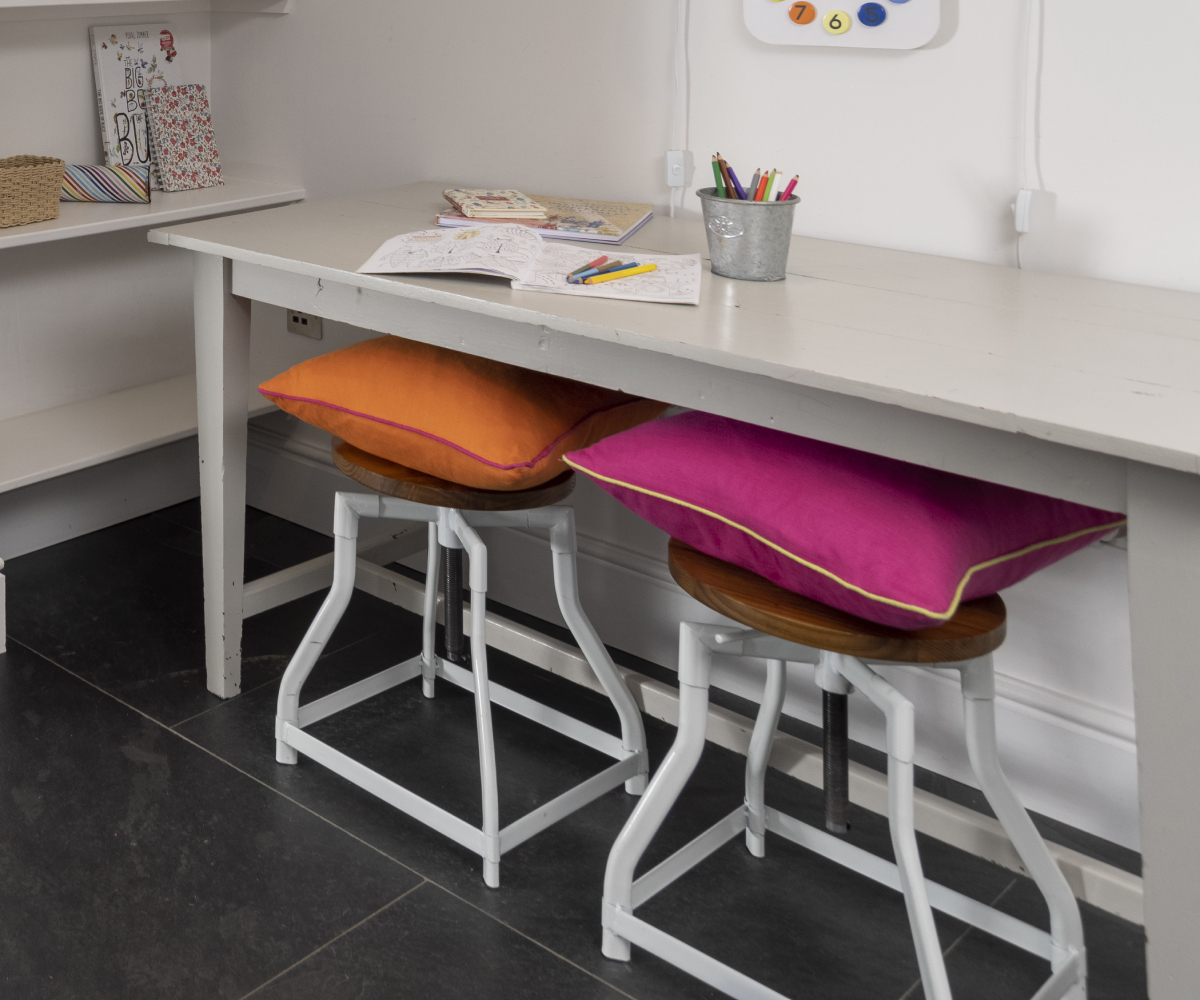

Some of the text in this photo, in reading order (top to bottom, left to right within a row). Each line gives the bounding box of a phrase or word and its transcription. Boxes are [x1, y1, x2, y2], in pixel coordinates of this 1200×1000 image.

[794, 5, 807, 20] 7
[865, 7, 878, 23] 5
[829, 14, 842, 29] 6
[124, 59, 133, 67] THE
[125, 67, 143, 89] BIG
